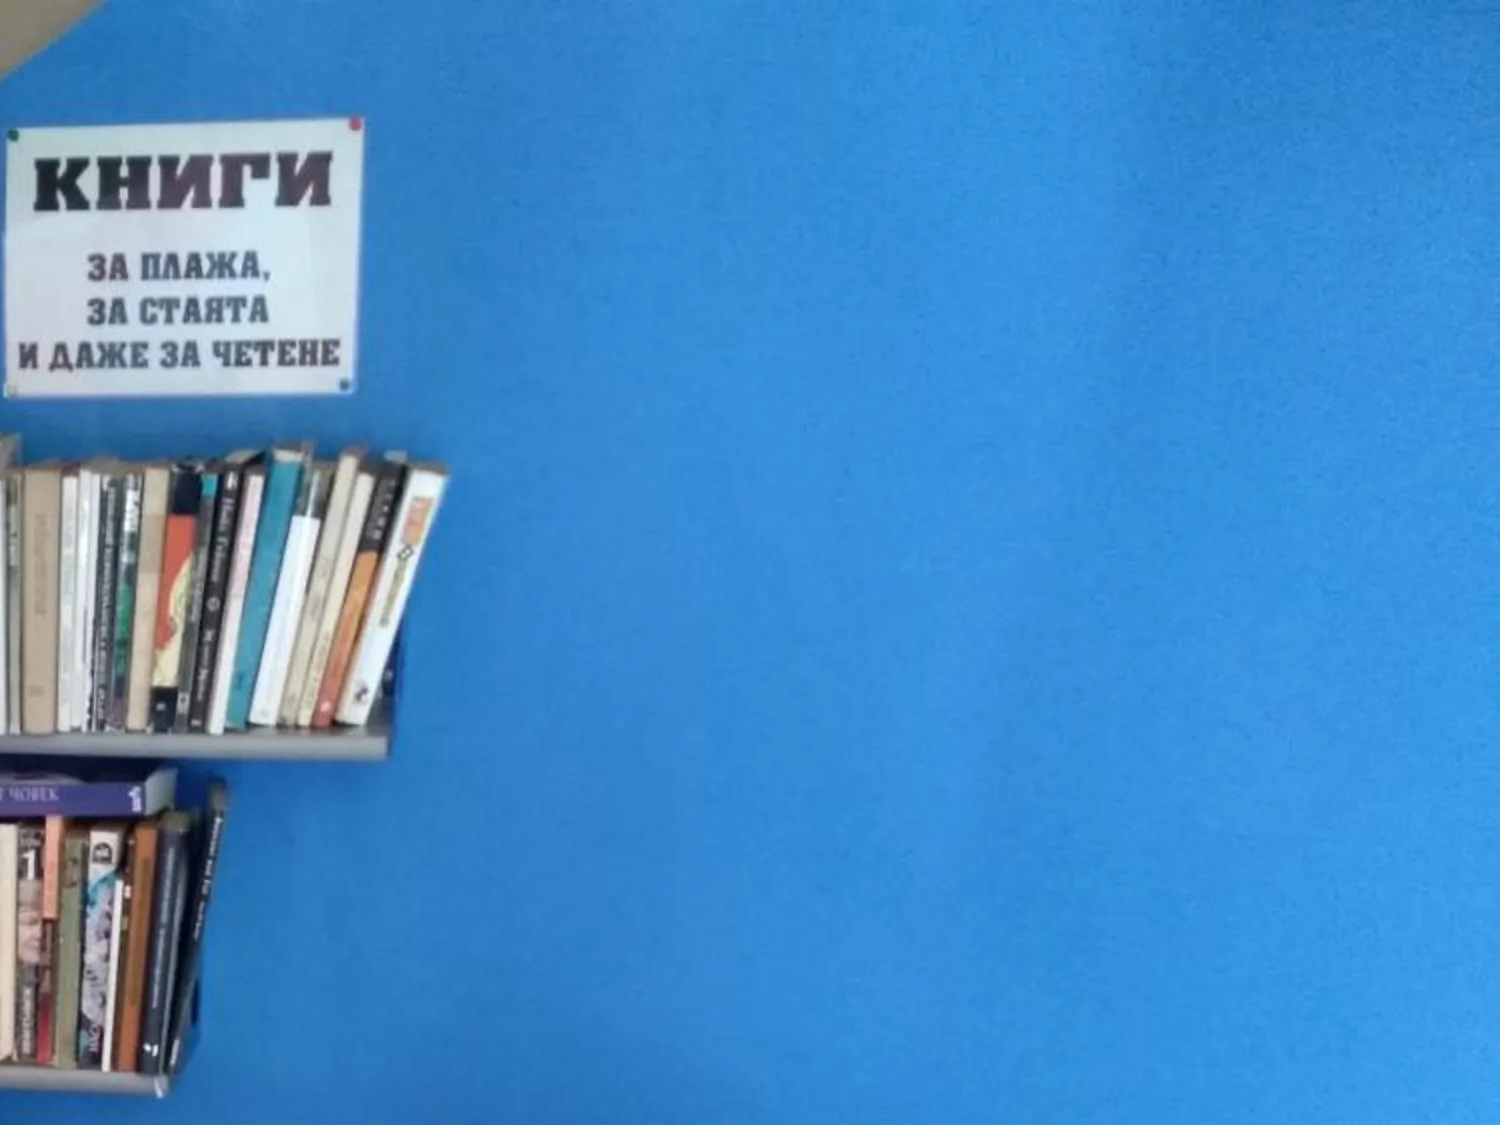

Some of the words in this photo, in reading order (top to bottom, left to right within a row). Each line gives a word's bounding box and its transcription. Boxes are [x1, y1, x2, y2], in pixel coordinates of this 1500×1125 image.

[33, 151, 333, 211] КНИГИ
[87, 253, 129, 281] ЗА
[140, 251, 271, 281] ПЛАЖА,
[87, 298, 128, 326] ЗА
[139, 295, 269, 325] СТАЯТА
[18, 342, 39, 369] И
[48, 342, 150, 372] ДАЖЕ
[159, 341, 200, 368] ЗА
[212, 339, 341, 367] ЧЕТЕНЕ
[9, 786, 60, 802] ЧОВЕК
[23, 850, 35, 881] 1
